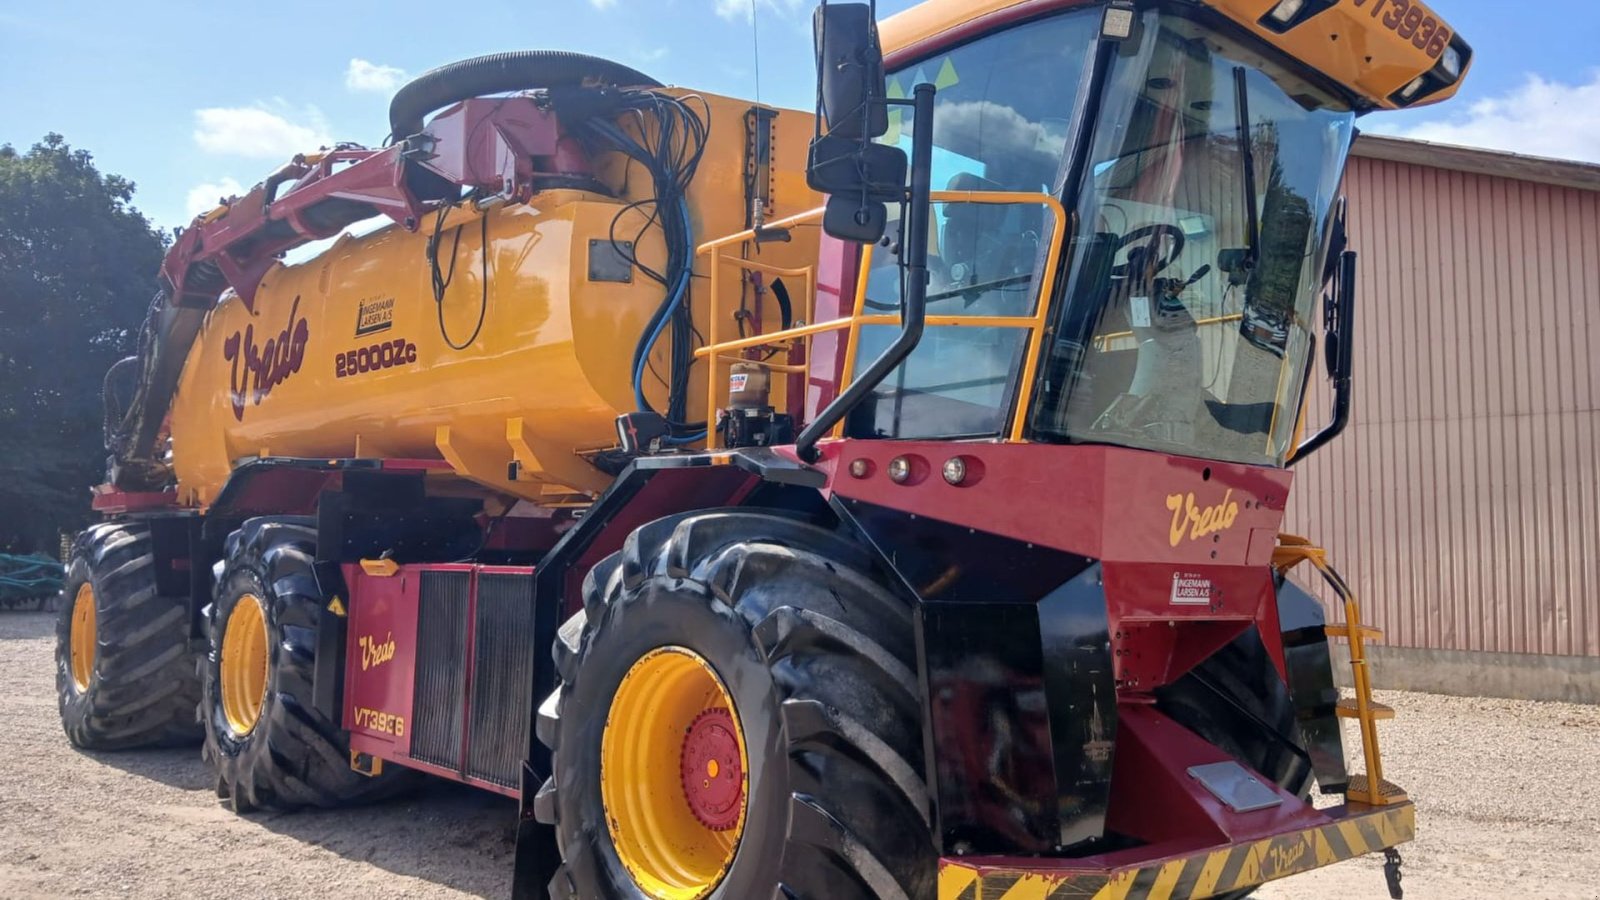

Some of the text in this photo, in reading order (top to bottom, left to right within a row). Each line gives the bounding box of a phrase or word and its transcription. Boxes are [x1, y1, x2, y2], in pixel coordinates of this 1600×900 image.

[1353, 0, 1450, 59] 3936
[224, 295, 309, 422] Vredo
[335, 338, 417, 378] 25000Zc
[1166, 488, 1238, 547] Vredo
[359, 631, 395, 671] Vredo
